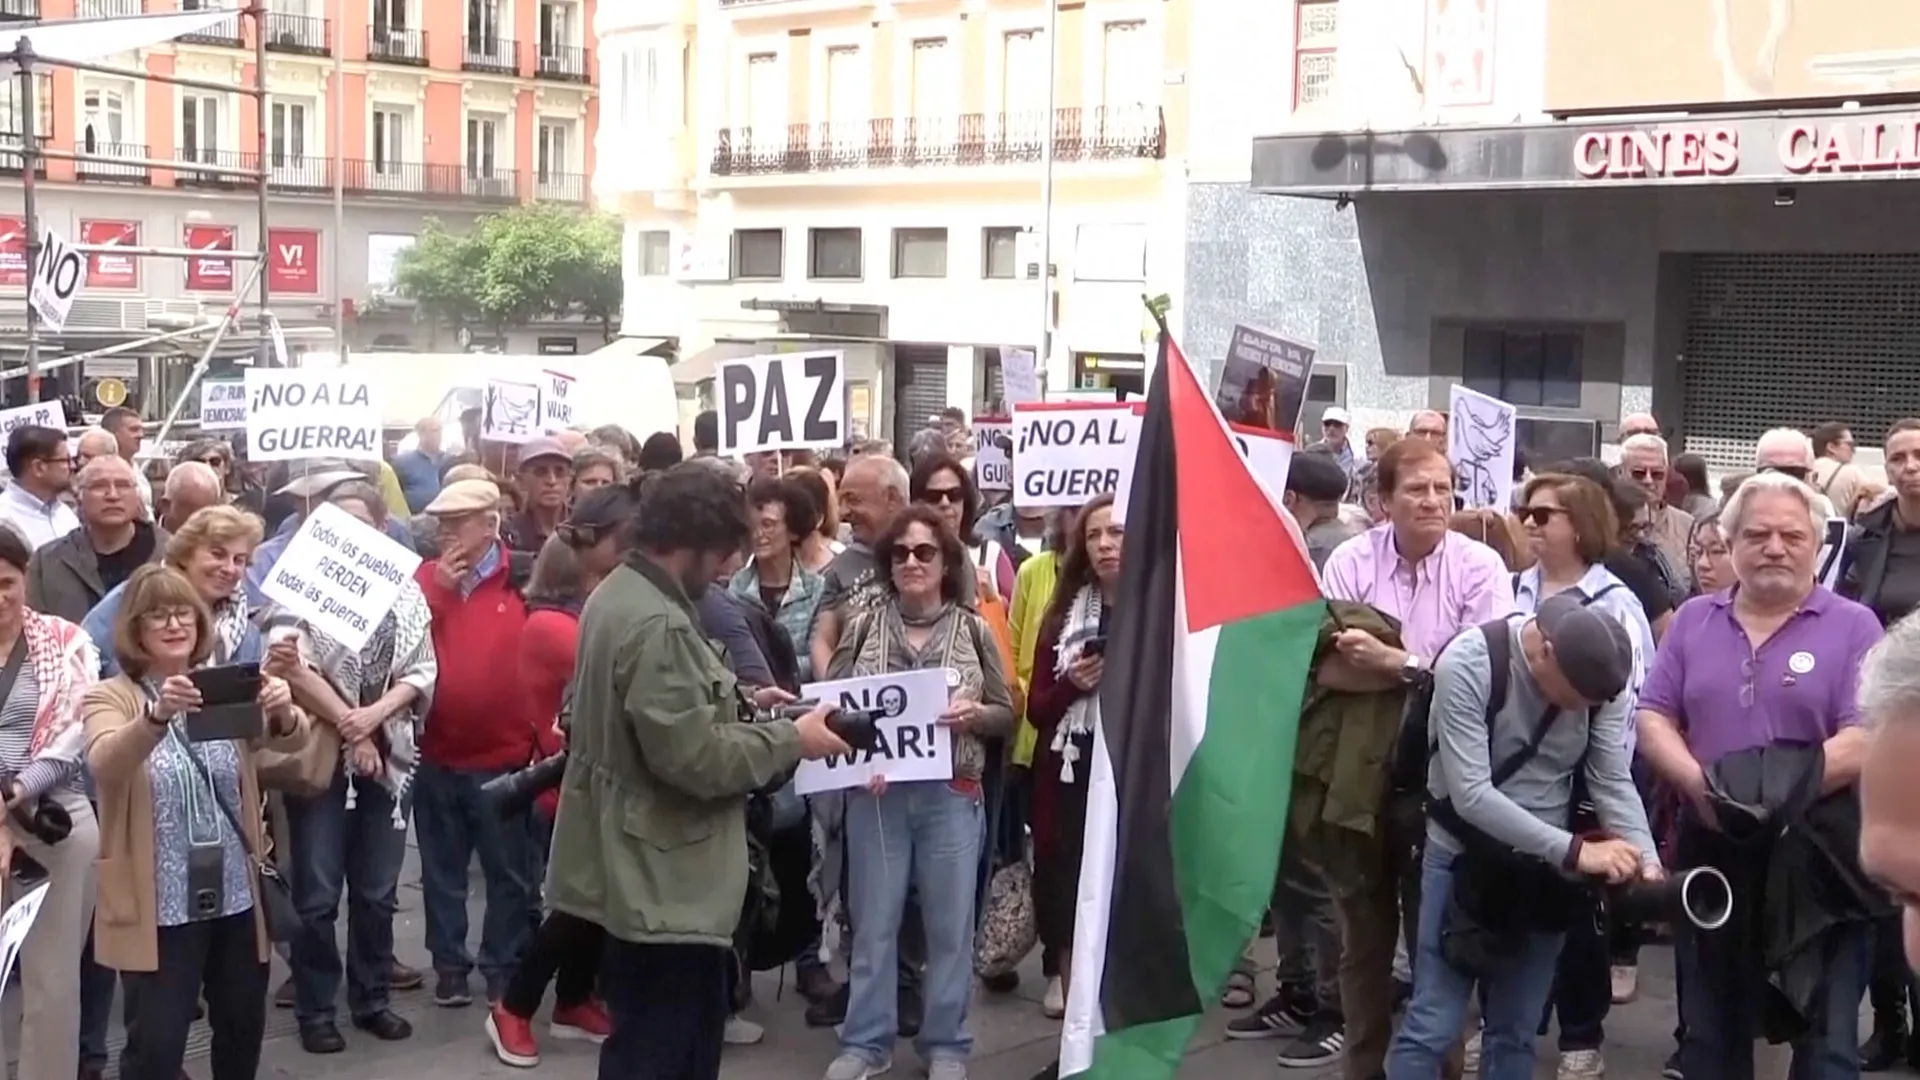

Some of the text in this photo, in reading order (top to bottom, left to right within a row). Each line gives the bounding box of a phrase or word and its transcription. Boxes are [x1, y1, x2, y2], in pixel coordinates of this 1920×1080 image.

[1573, 127, 1739, 179] CINES
[38, 231, 80, 299] NO
[252, 382, 370, 413] ¡NO A LA
[552, 378, 568, 398] NO
[723, 356, 837, 449] PAZ
[203, 407, 247, 423] DEMOCRAC
[258, 425, 377, 452] GUERRA!
[1019, 418, 1128, 454] ¡NO A L
[1024, 468, 1120, 497] GUERR
[309, 519, 405, 586] Todos los pueblos
[316, 555, 372, 599] PIERDEN
[276, 568, 369, 634] todas las guerras.
